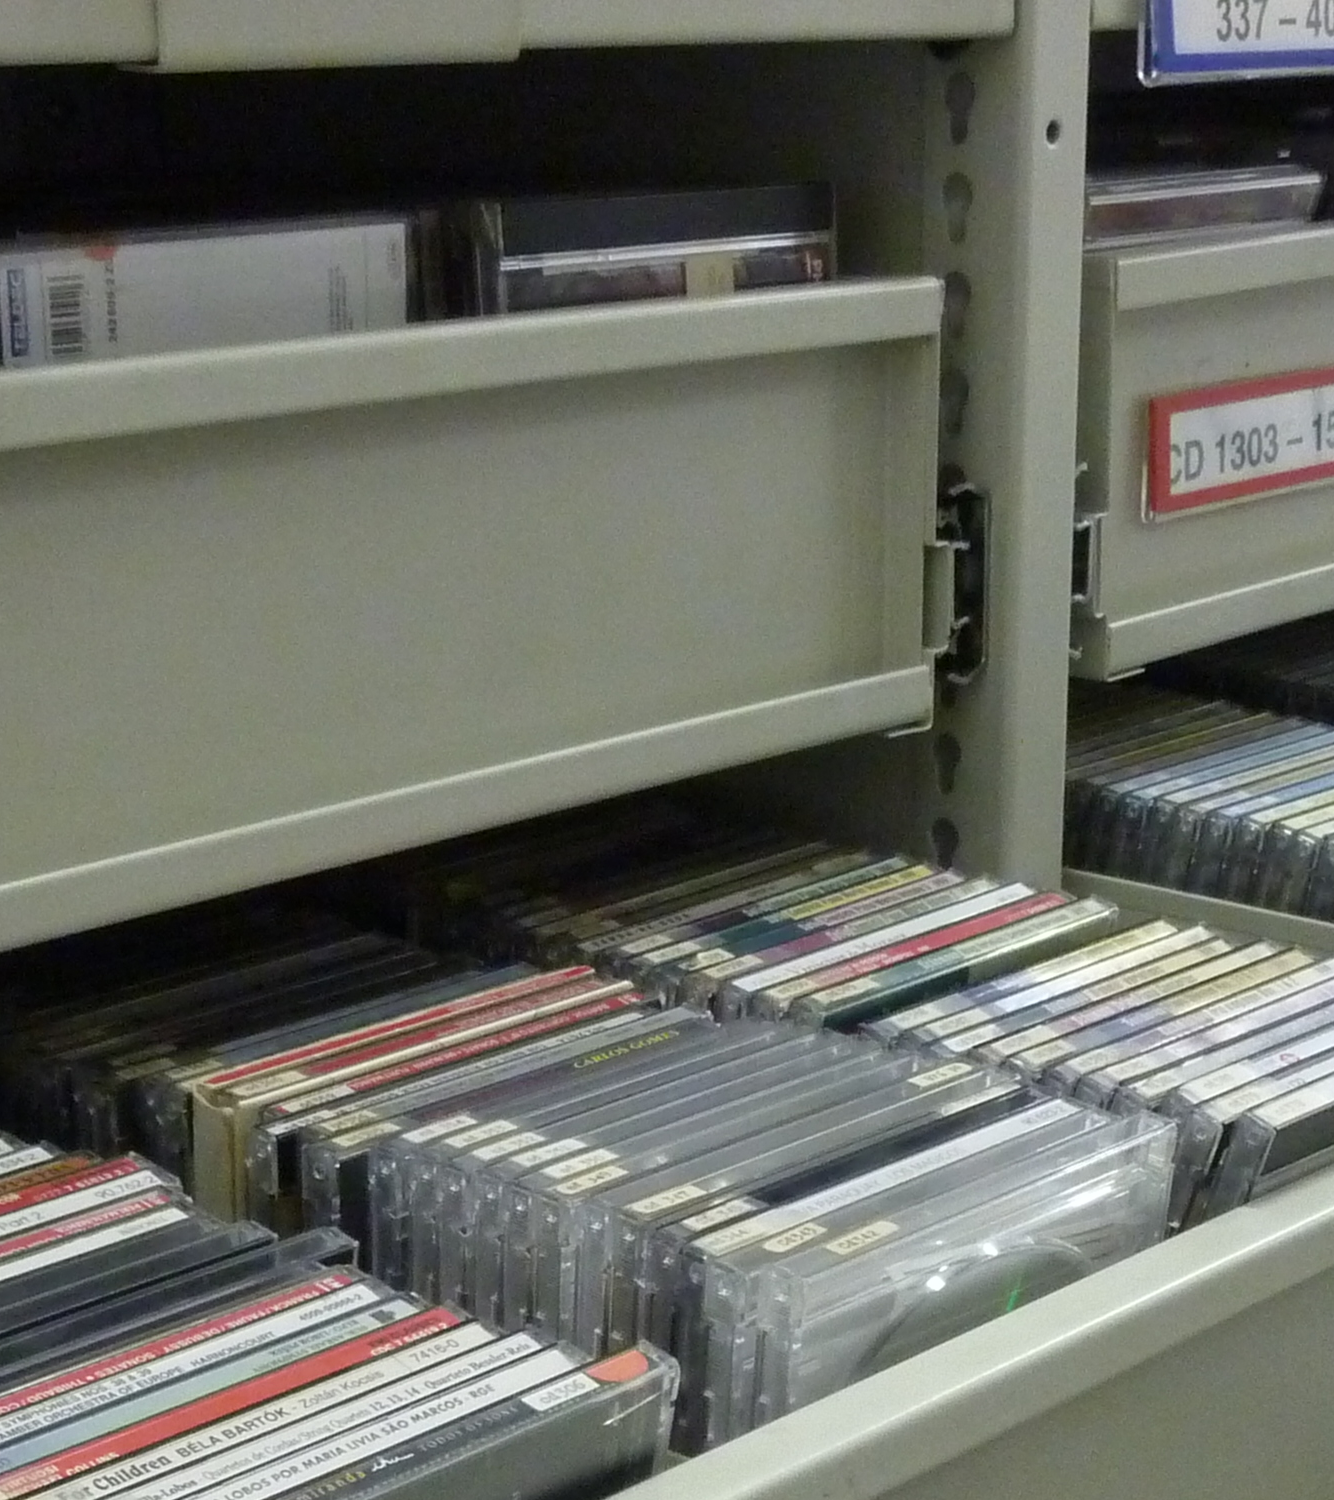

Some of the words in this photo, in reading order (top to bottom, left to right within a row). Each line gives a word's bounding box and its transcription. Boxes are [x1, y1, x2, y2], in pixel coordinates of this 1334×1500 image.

[1216, 0, 1265, 41] 337
[1216, 426, 1278, 473] 1303
[574, 1044, 630, 1069] CARLOS
[630, 1029, 679, 1055] GOMES
[42, 1392, 118, 1429] ORCHESTRA
[136, 1366, 184, 1392] EUROPE
[189, 1331, 275, 1368] HARNONCOURT
[97, 1352, 156, 1380] SONATES
[92, 1453, 172, 1492] Children
[176, 1432, 221, 1460] BÉLA
[222, 1406, 289, 1447] BARTÓK
[299, 1380, 340, 1408] Zoltán
[339, 1369, 385, 1396] Kocsis
[409, 1337, 461, 1364] 7416-0
[272, 1464, 302, 1483] POR
[302, 1446, 347, 1473] MARIA
[348, 1429, 383, 1455] LIVIA
[383, 1417, 410, 1438] SÃO
[411, 1394, 464, 1424] MARCOS
